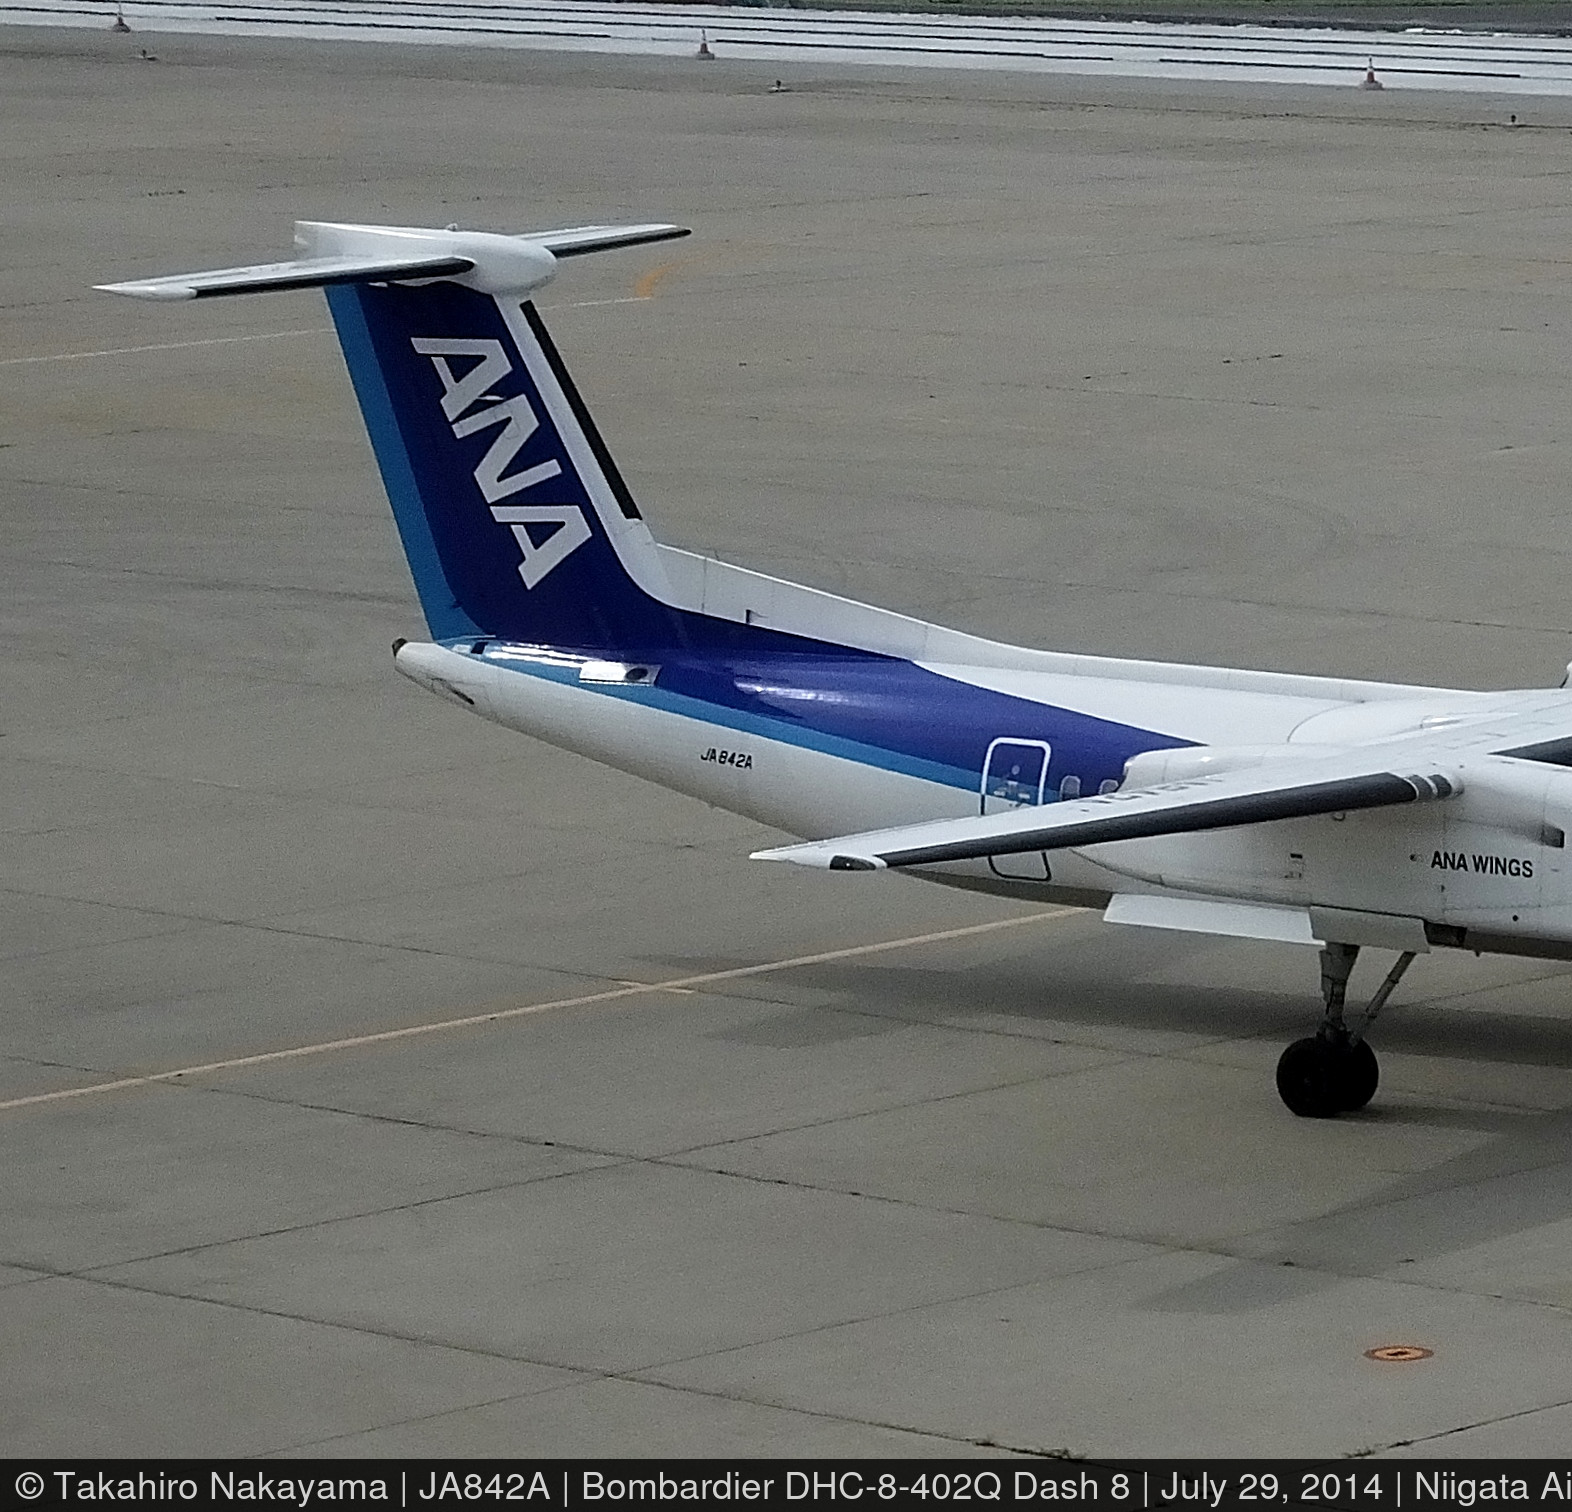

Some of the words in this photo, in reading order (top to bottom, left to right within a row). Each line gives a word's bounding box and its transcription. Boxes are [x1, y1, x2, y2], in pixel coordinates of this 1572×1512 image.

[411, 337, 593, 590] ANA
[700, 747, 752, 770] JA842A
[1431, 850, 1468, 872] ANA
[1472, 854, 1533, 878] WINGS
